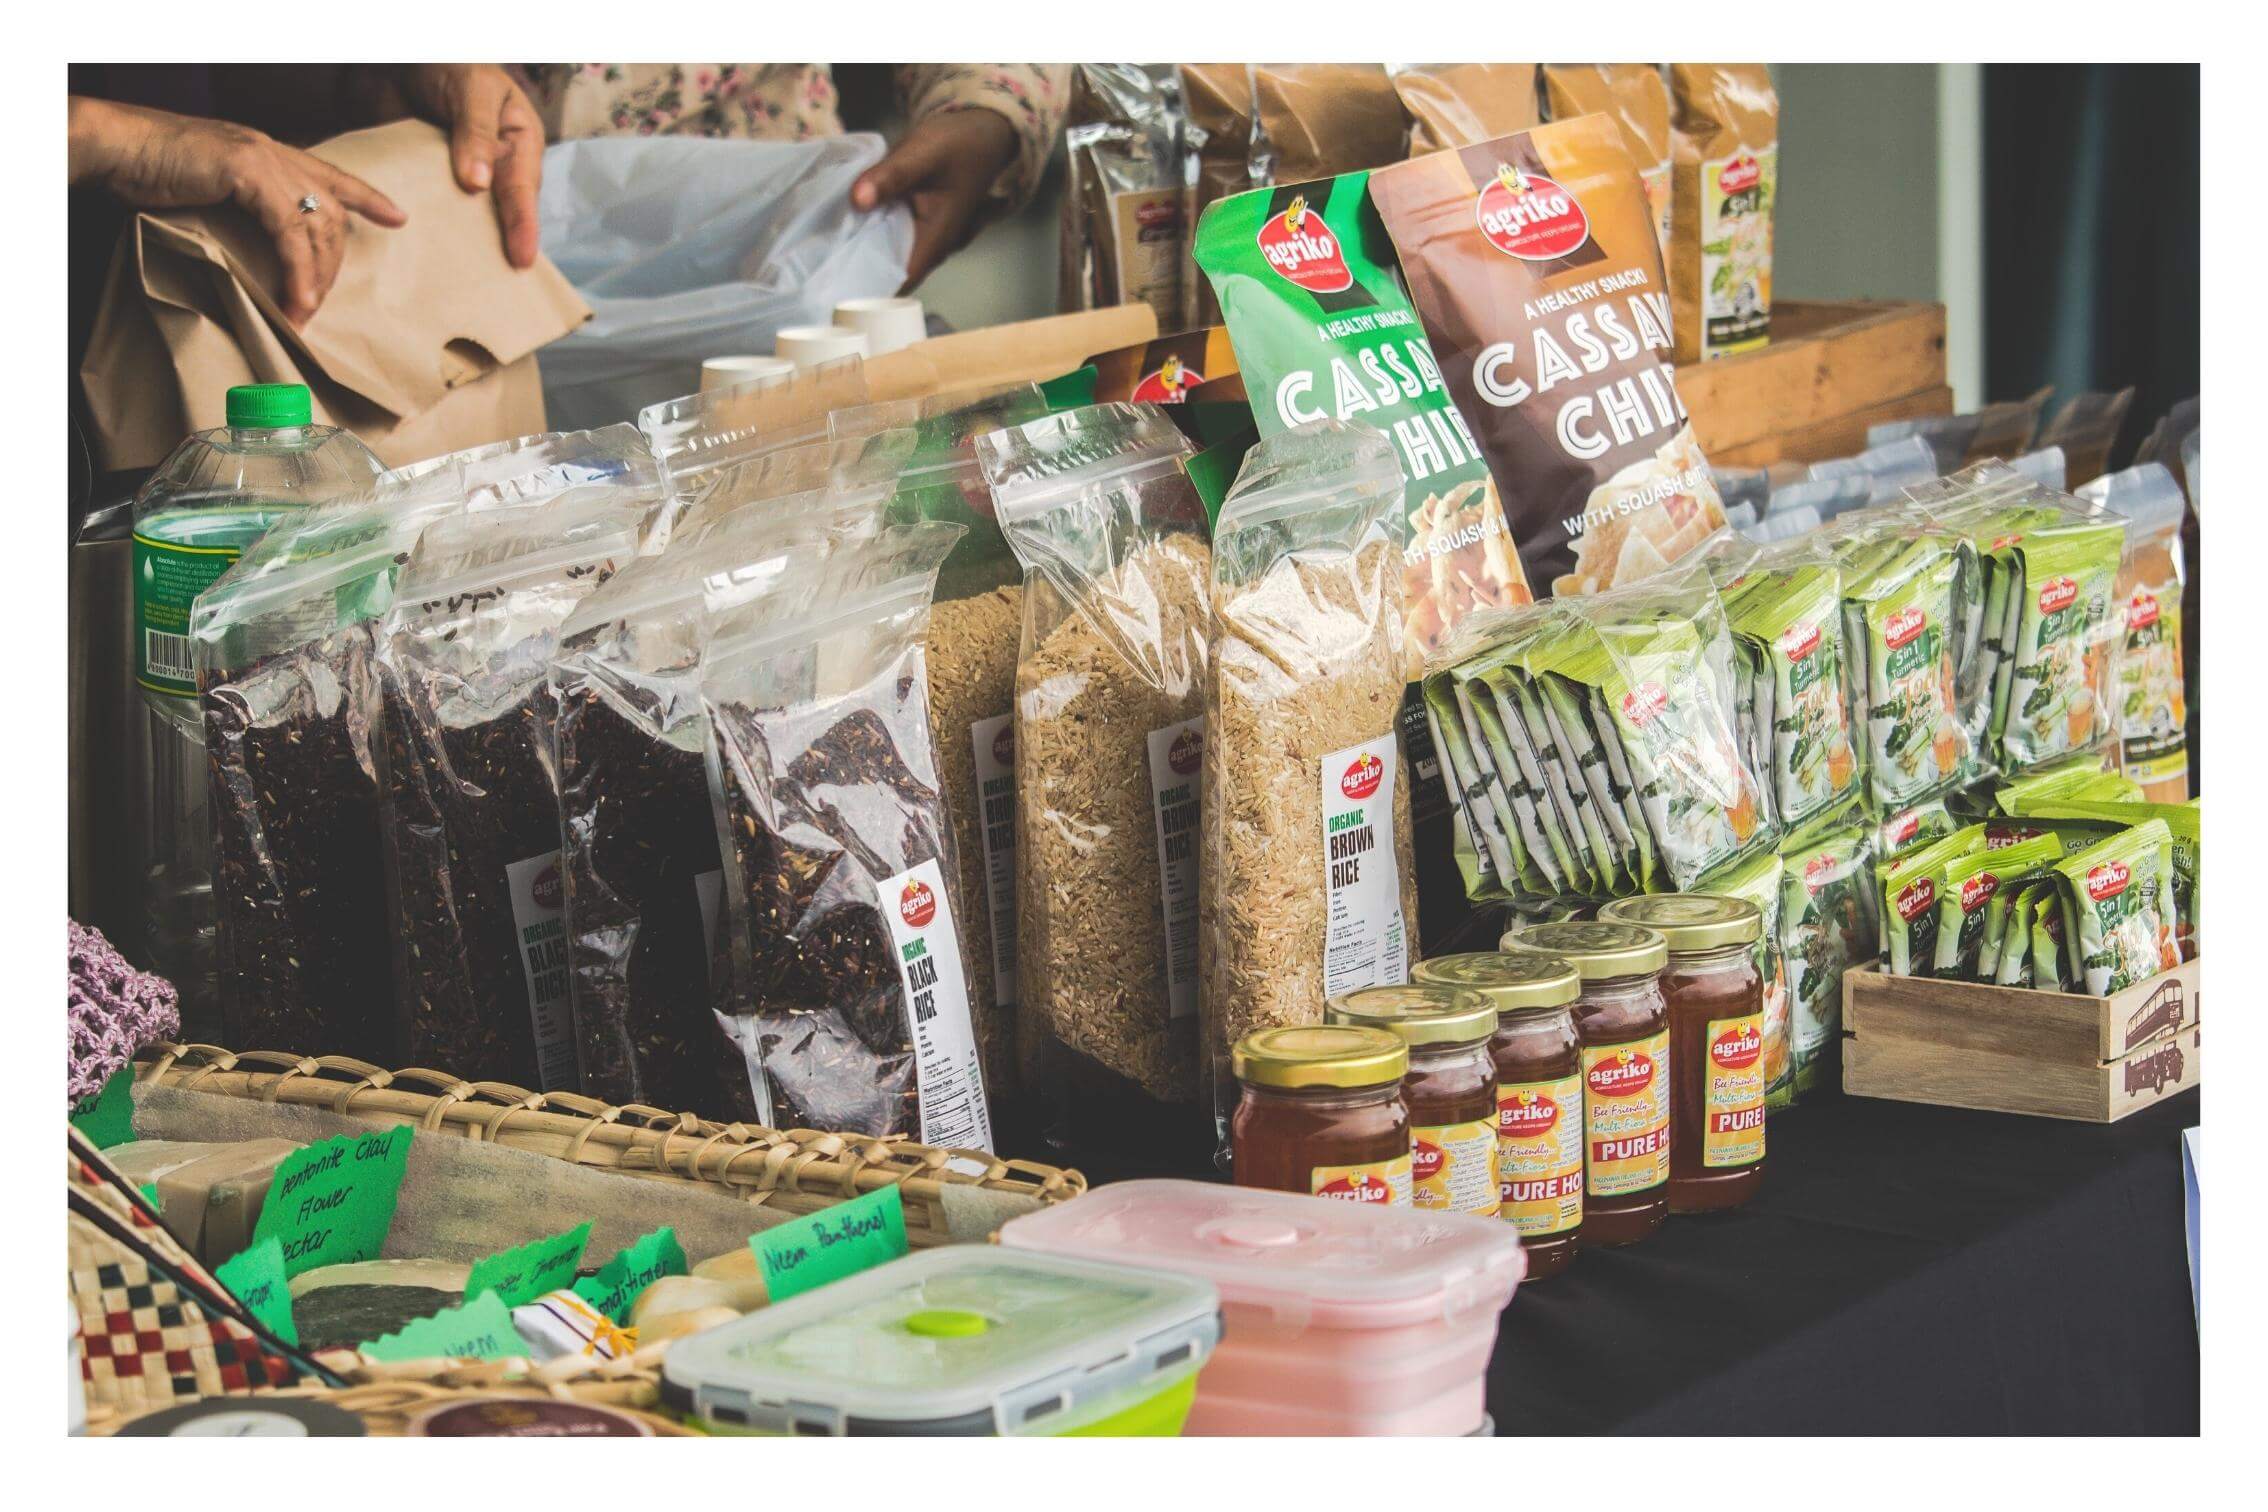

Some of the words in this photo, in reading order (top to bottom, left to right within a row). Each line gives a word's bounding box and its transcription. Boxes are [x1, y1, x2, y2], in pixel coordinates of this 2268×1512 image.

[1482, 193, 1569, 236] agriko
[1264, 230, 1334, 270] agriko
[1524, 303, 1536, 320] A
[1534, 282, 1600, 314] HEALTHY
[1600, 268, 1648, 293] SNACK!
[1317, 325, 1330, 342] A
[1329, 315, 1376, 338] HEALTHY
[1472, 293, 1674, 408] CASSAV
[1276, 338, 1443, 429] CASSA
[1563, 505, 1614, 536] WITH
[1620, 475, 1684, 515] SQUASH
[1402, 547, 1426, 567] TH
[1427, 522, 1487, 557] SQUASH
[1344, 765, 1380, 788] agriko
[1329, 808, 1364, 833] ORGANIC
[1330, 824, 1374, 861] BROWN
[1332, 858, 1360, 890] RICE
[2089, 867, 2127, 891] agriko
[902, 891, 932, 915] agriko
[902, 937, 927, 962] ORGANIC
[907, 955, 938, 992] BLACK
[914, 989, 938, 1024] RICE
[1713, 1036, 1760, 1057] agriko
[1590, 1063, 1650, 1085] agriko
[1714, 1078, 1727, 1089] Bee
[1501, 1105, 1554, 1125] griko
[1594, 1107, 1608, 1118] Bee
[1719, 1109, 1761, 1132] PURE
[1602, 1134, 1657, 1161] PURE
[1501, 1179, 1558, 1202] PURE
[1562, 1171, 1582, 1194] HO
[283, 1229, 332, 1263] ectar
[763, 1248, 809, 1276] Neem
[812, 1205, 887, 1249] Panthenol
